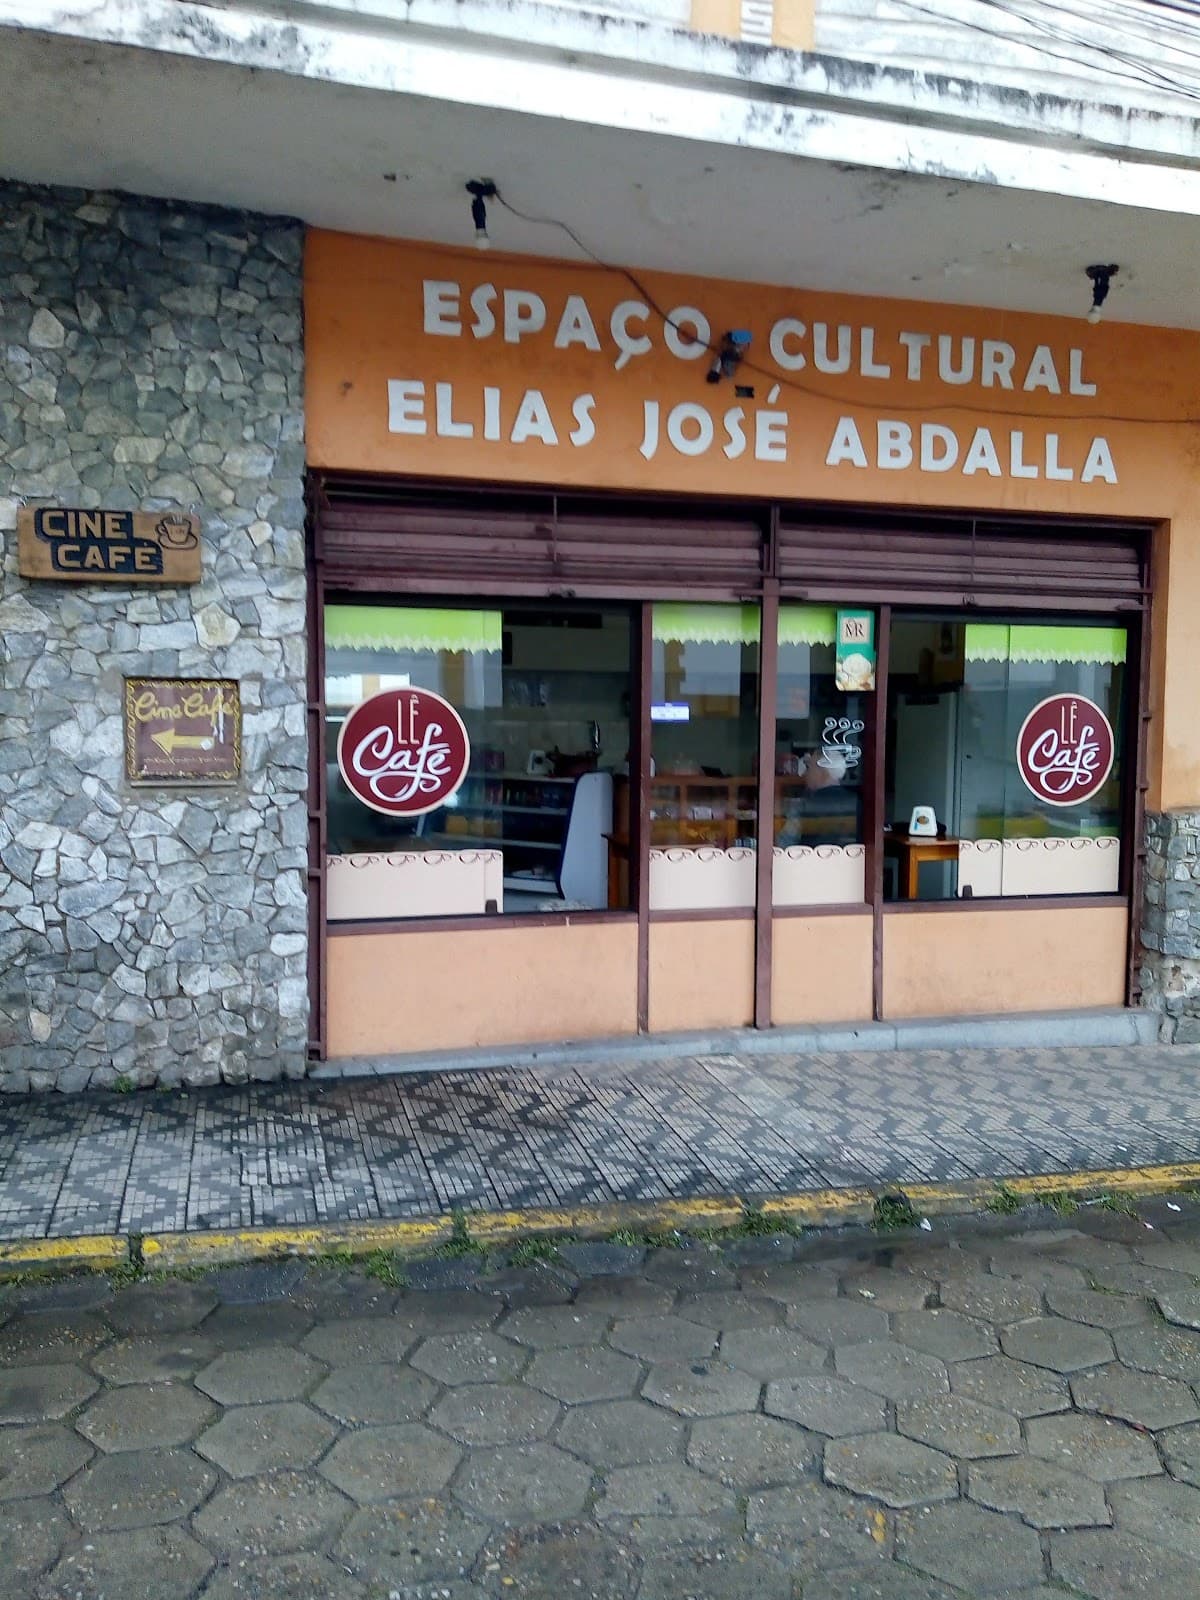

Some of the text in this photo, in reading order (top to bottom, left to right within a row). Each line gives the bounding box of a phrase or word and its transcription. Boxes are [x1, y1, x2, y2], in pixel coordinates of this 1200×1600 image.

[422, 279, 1097, 396] ESPAÇO CULTURAL
[387, 378, 1119, 484] ELIAS JOSÉ ABDALLA
[41, 511, 128, 538] CINE
[352, 723, 451, 802] Café
[1028, 725, 1100, 794] Café
